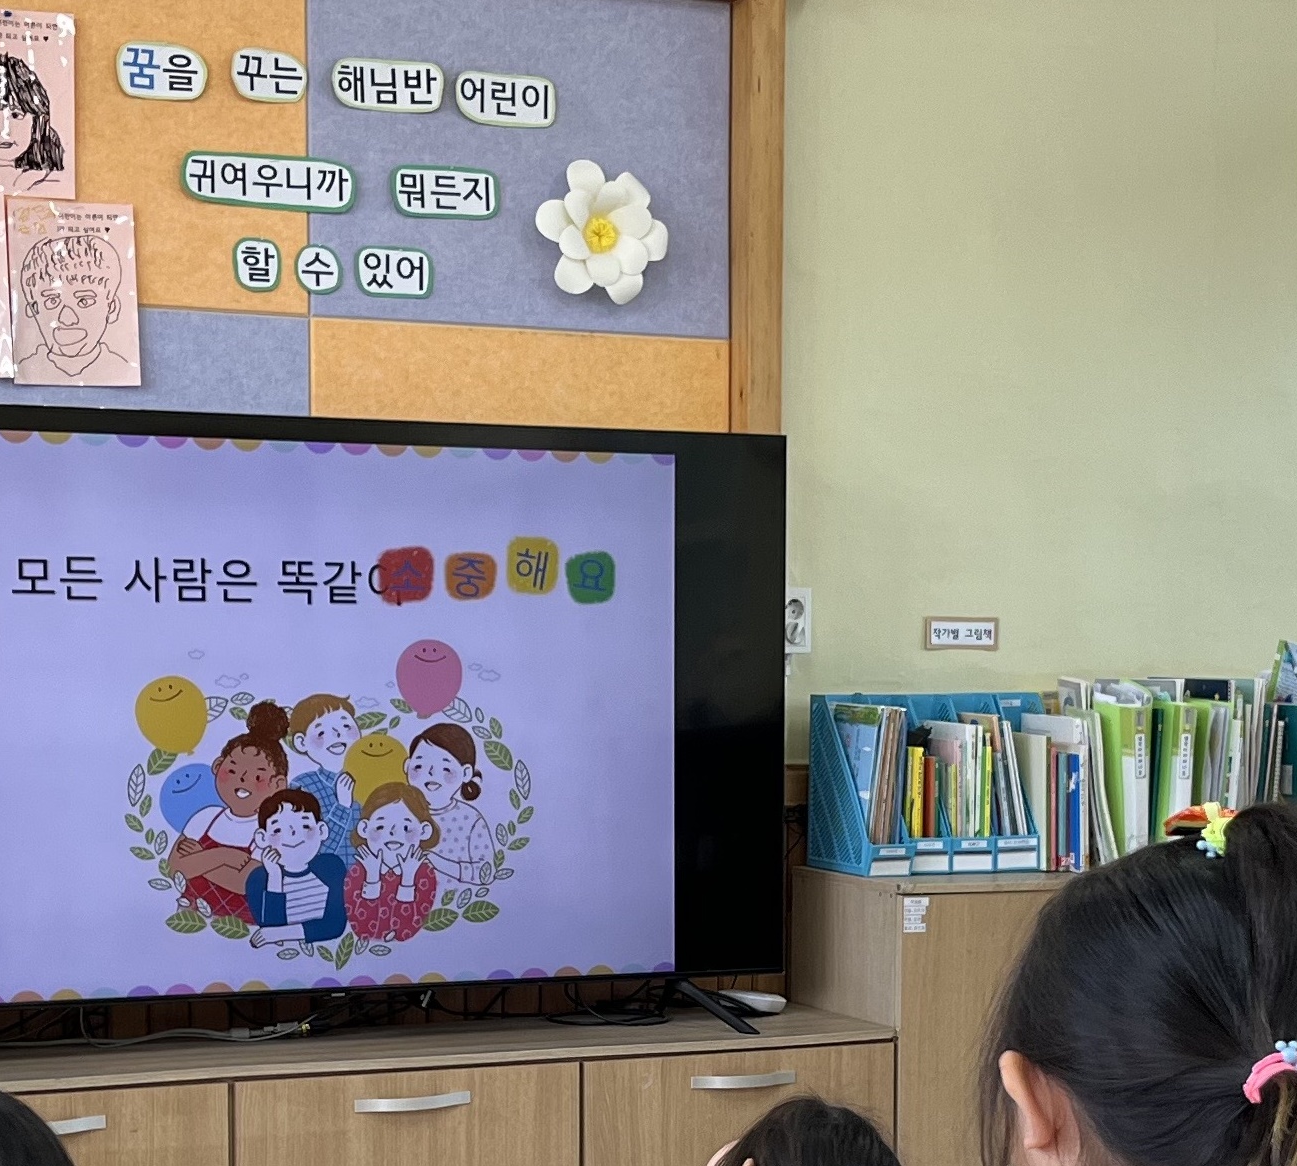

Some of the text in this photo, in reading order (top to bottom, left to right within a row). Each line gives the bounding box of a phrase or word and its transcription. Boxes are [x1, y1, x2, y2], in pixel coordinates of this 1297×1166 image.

[122, 47, 550, 119] 꿈을 꾸는 해님반 어린이
[187, 157, 491, 212] 귀여우니까 뭐든지
[241, 244, 425, 292] 할 수 있어
[11, 556, 102, 601] 모든
[124, 557, 257, 603] 사람은
[965, 628, 993, 640] 그림책
